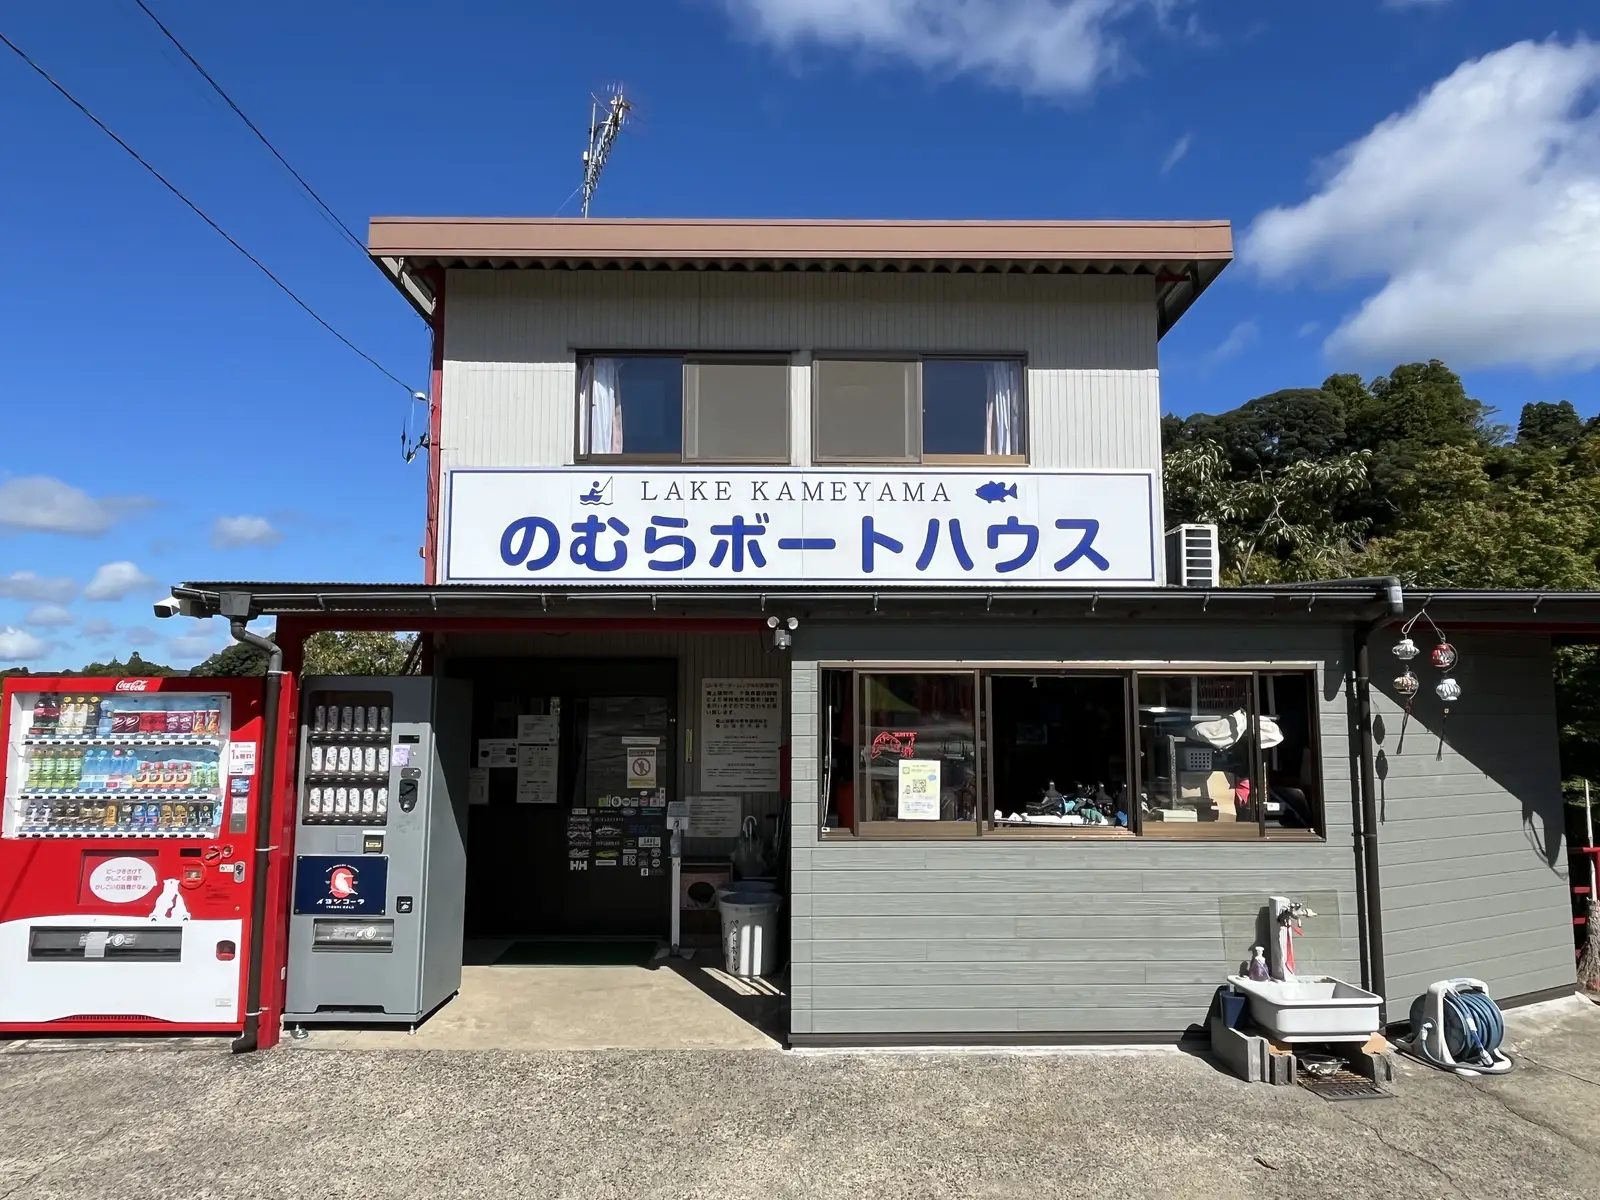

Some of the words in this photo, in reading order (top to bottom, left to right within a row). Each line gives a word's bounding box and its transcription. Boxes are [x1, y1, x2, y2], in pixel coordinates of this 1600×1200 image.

[641, 480, 732, 502] LAKE
[751, 480, 951, 503] KAMEYAMA
[499, 512, 1110, 574] のむらボートハウス
